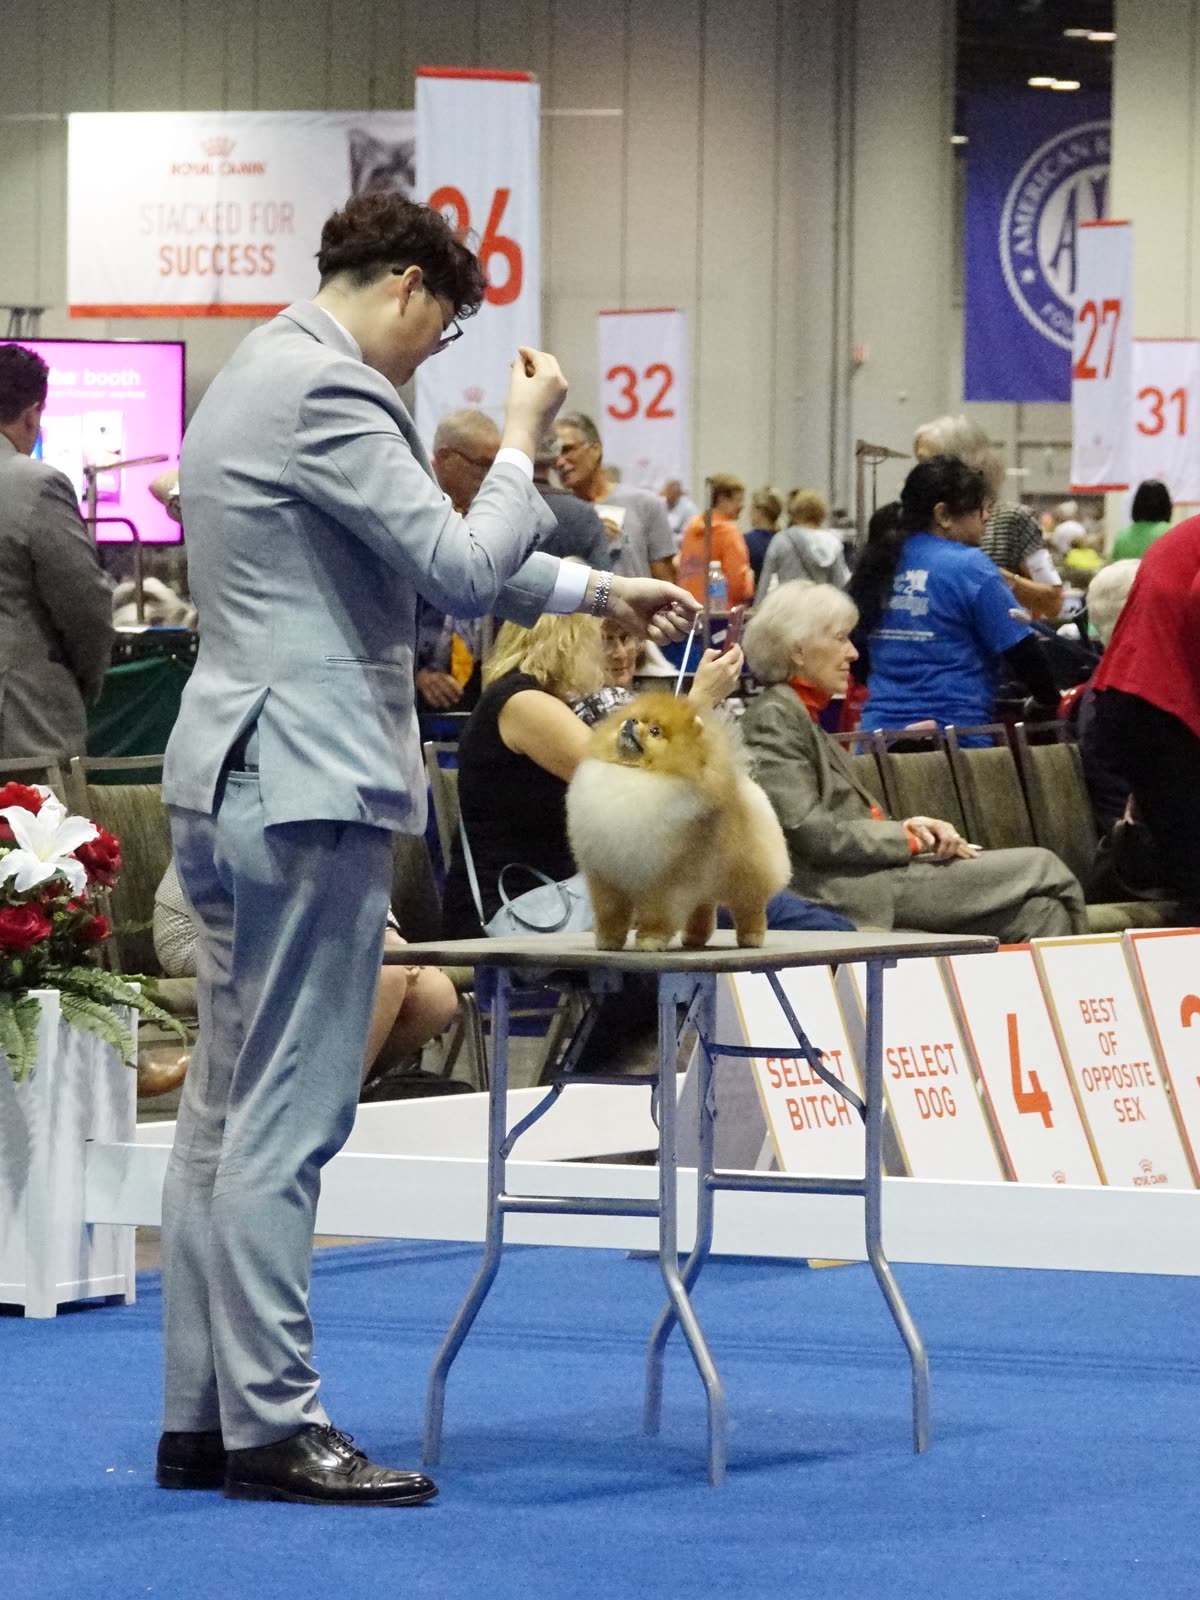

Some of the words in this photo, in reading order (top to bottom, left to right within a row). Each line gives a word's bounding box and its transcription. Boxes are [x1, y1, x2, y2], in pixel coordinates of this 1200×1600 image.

[1012, 140, 1091, 256] AMERICAN
[140, 201, 242, 236] STACKED
[249, 201, 296, 236] FOR
[159, 243, 275, 277] SUCCESS
[1073, 298, 1122, 380] 27
[83, 367, 141, 386] booth
[605, 363, 676, 421] 32
[1136, 385, 1188, 437] 31
[1078, 997, 1118, 1025] BEST
[1098, 1031, 1118, 1056] OF
[886, 1043, 959, 1080] SELECT
[1007, 1013, 1054, 1129] 4
[1081, 1061, 1156, 1093] OPPOSITE
[785, 1093, 853, 1132] BITCH
[913, 1085, 958, 1120] DOG
[1113, 1096, 1147, 1123] SEX
